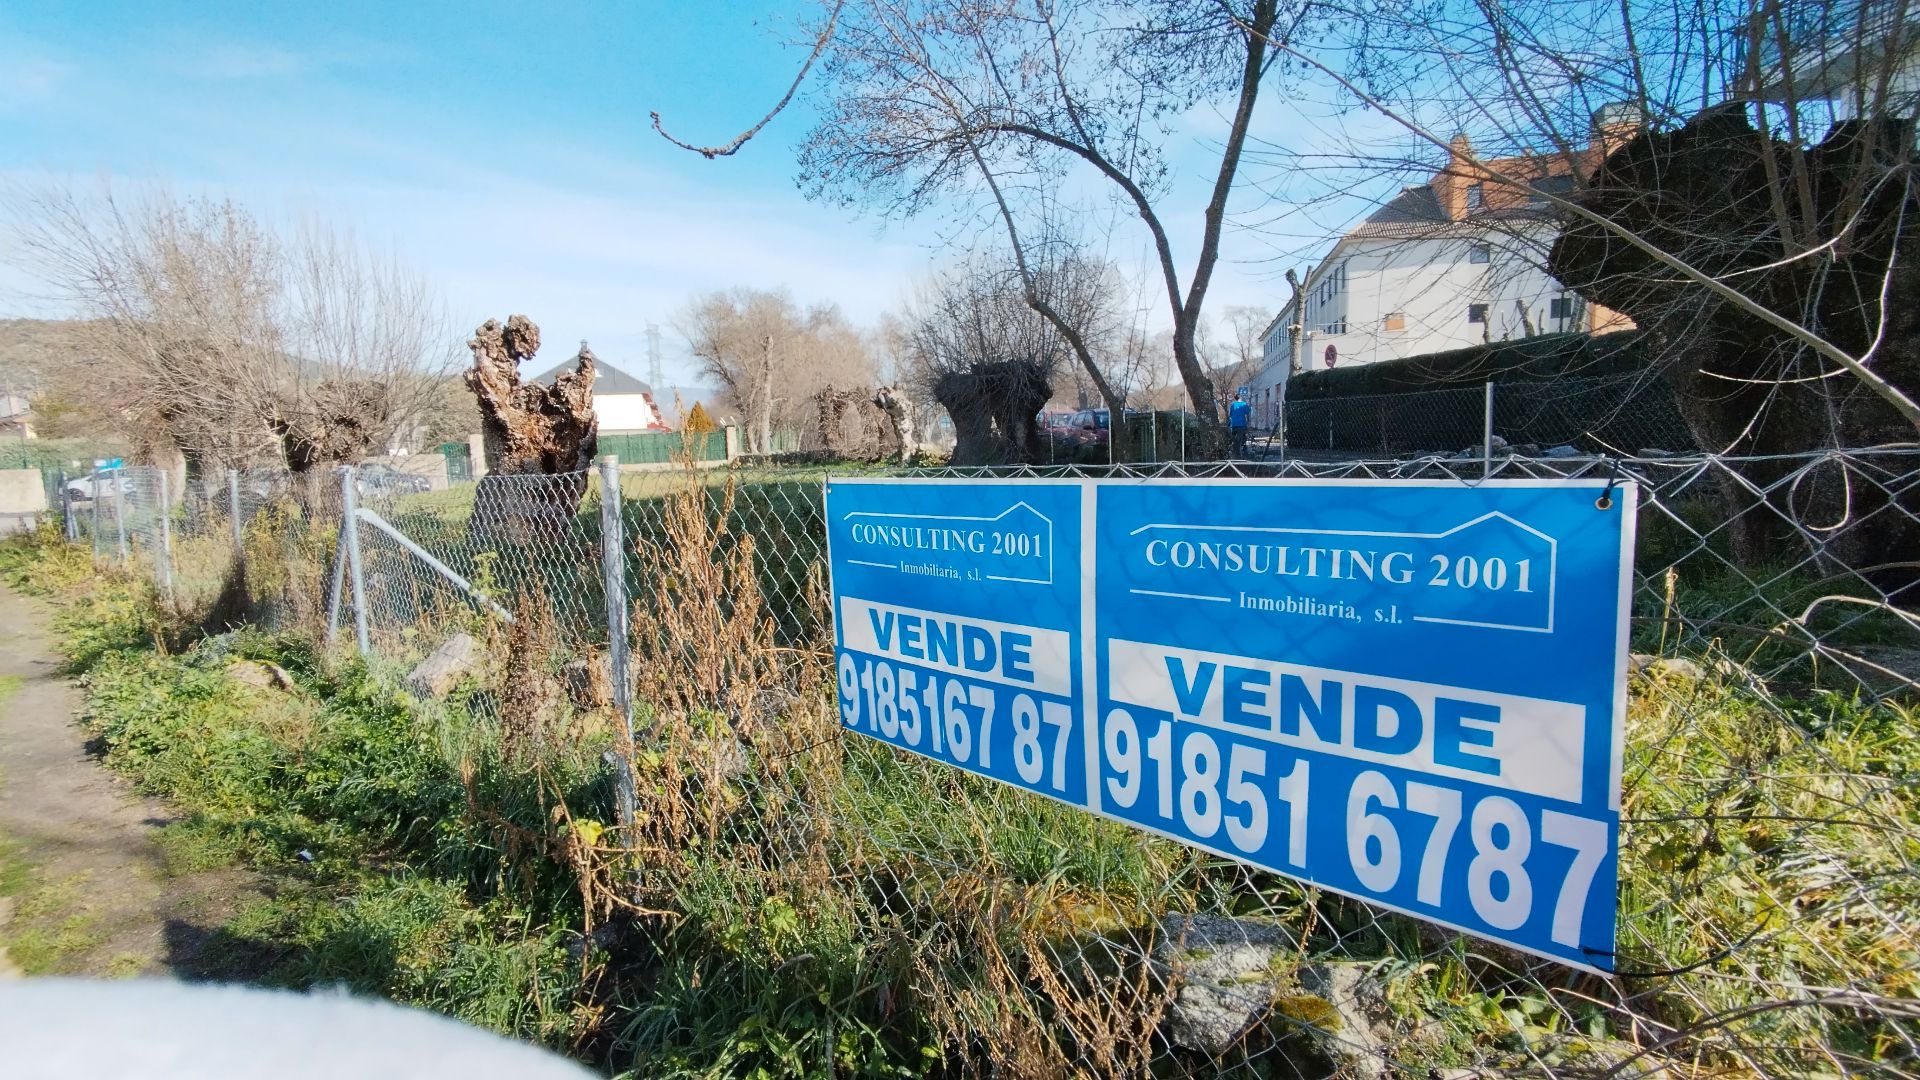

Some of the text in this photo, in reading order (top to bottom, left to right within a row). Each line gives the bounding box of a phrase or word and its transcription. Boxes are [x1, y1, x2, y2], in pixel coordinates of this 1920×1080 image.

[852, 523, 1043, 558] CONSULTING 2001
[900, 560, 962, 582] Inmobiliaria,
[1145, 540, 1535, 593] CONSULTING 2001
[1239, 591, 1403, 625] Inmobiliaria, s.l.
[868, 608, 1035, 684] VENDE
[839, 653, 1072, 793] 9185167 87
[1164, 656, 1502, 777] VENDE
[1104, 709, 1609, 950] 91851 6787
